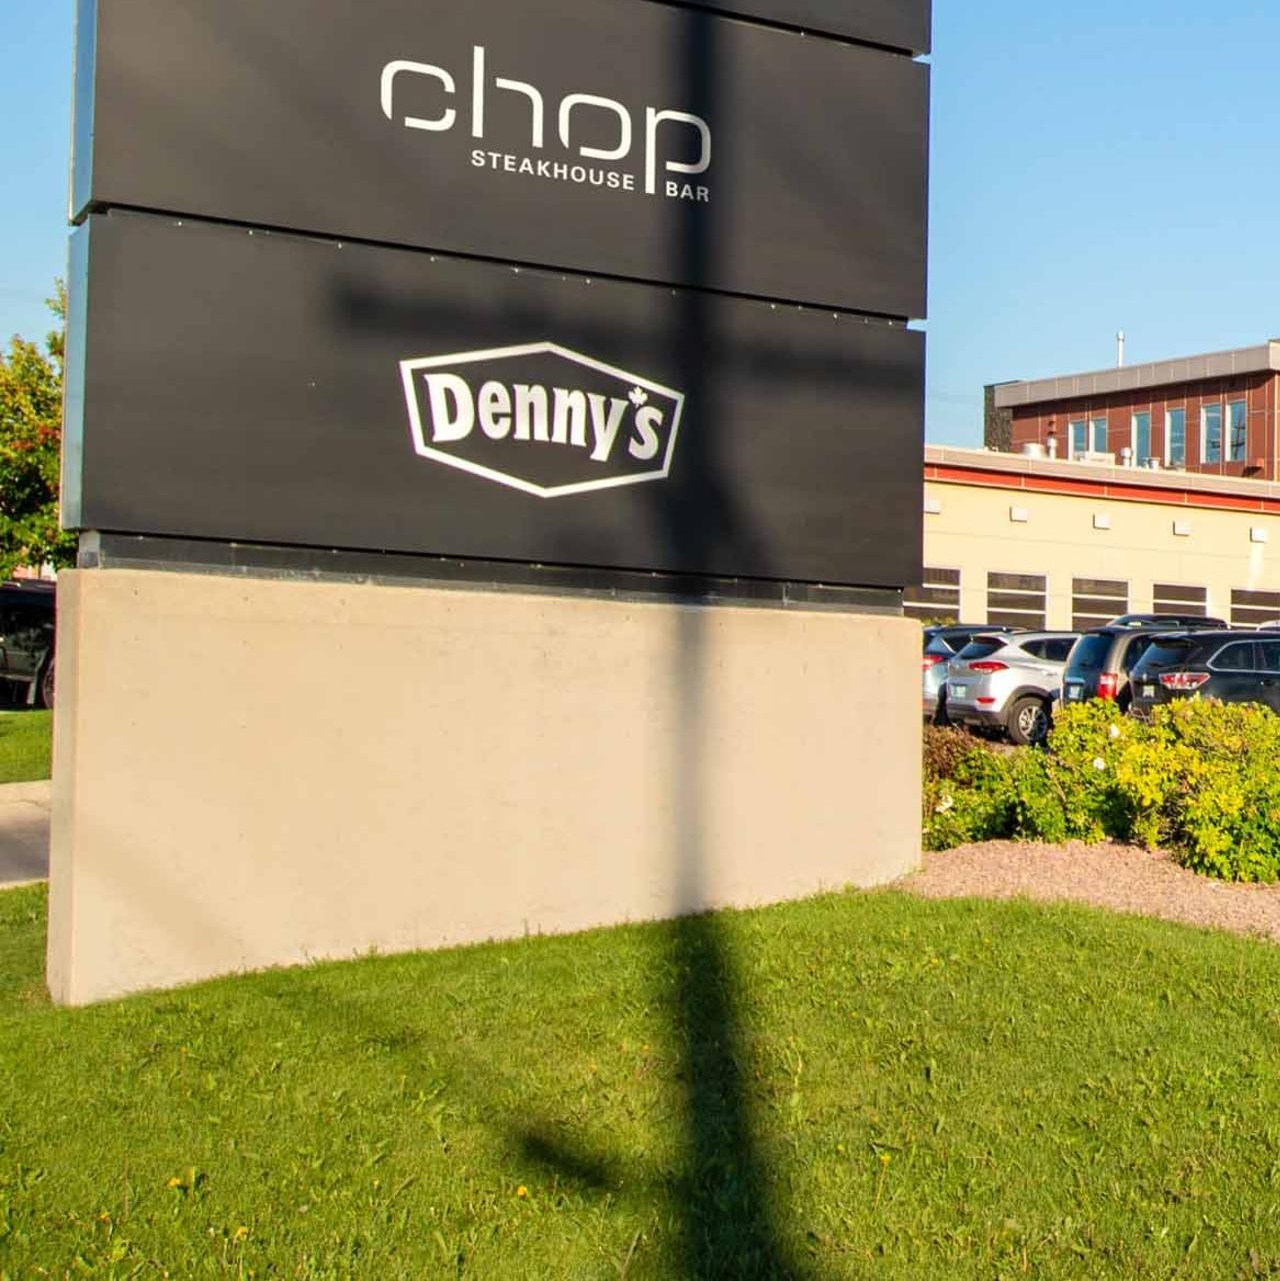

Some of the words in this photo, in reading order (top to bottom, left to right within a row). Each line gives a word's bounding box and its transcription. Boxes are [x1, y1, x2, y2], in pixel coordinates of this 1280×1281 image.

[380, 45, 712, 195] chop
[470, 149, 635, 191] STEAKHOUSE
[665, 180, 710, 203] BAR
